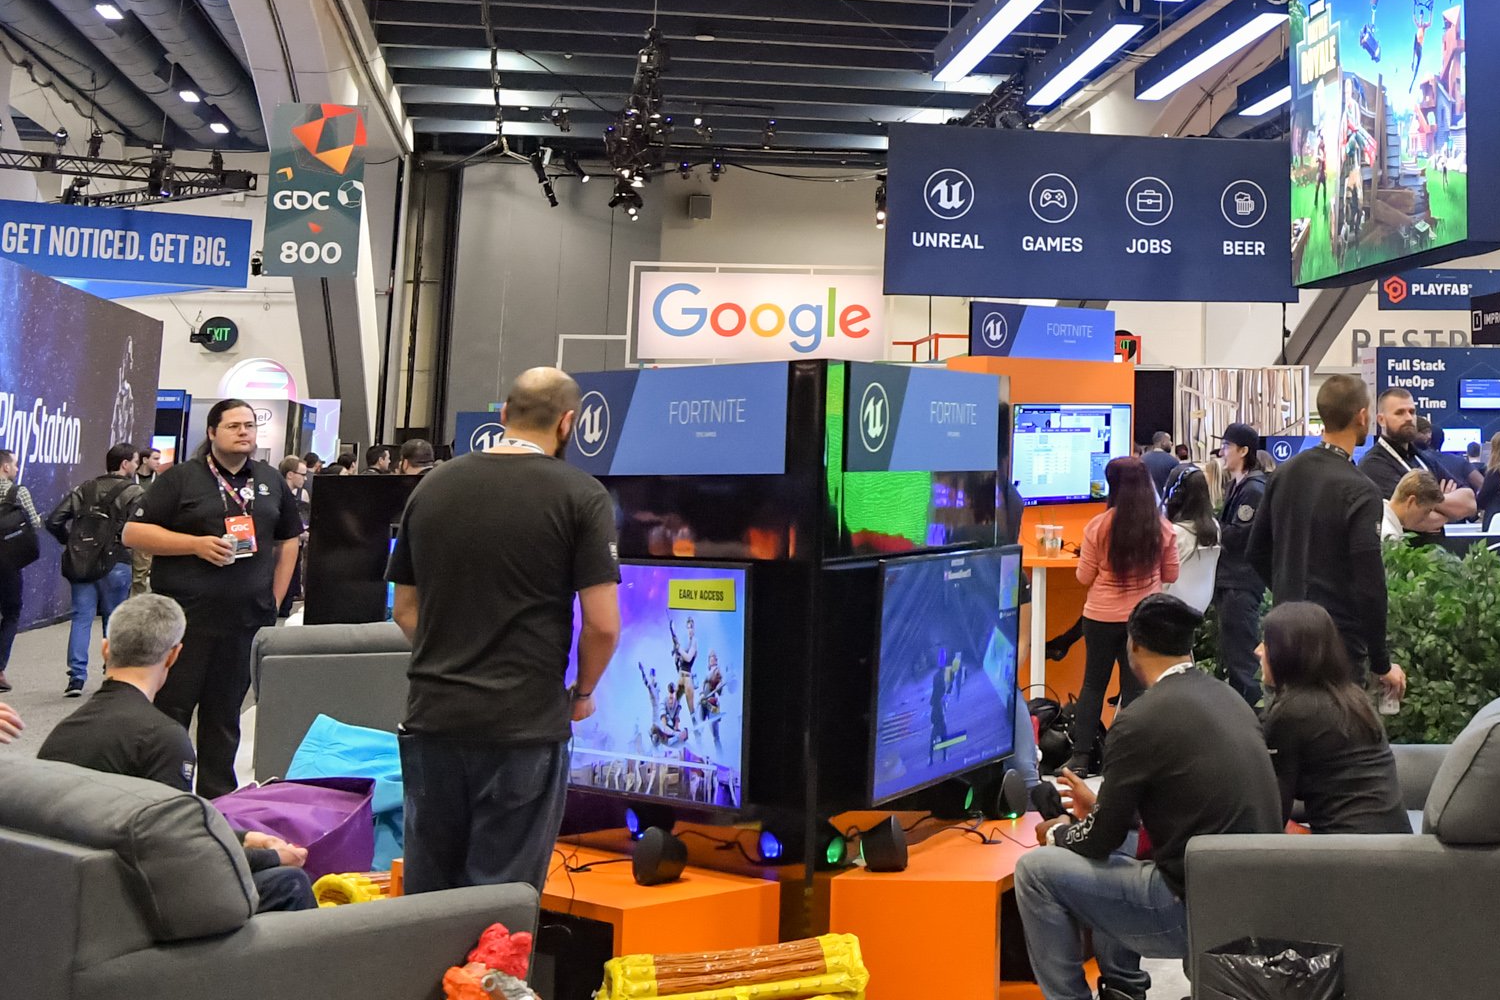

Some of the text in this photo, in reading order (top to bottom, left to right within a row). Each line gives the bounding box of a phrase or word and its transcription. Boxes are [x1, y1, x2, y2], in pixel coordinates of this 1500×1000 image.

[273, 190, 330, 211] GDC
[2, 221, 231, 267] GET NOTICED. GET BIG.
[912, 231, 984, 250] UNREAL
[1022, 236, 1083, 252] GAMES
[1126, 239, 1172, 255] JOBS
[1223, 240, 1266, 256] BEER
[280, 241, 342, 264] 800
[652, 282, 871, 353] Google
[1046, 322, 1094, 338] FORTNITE
[1387, 358, 1446, 371] Full Stack
[1387, 375, 1434, 390] LiveOps
[1414, 396, 1447, 409] -Time
[669, 398, 747, 425] FORTNITE
[930, 401, 977, 425] FORTNITE
[230, 523, 250, 532] GDC
[679, 588, 723, 602] EARLY ACCESS
